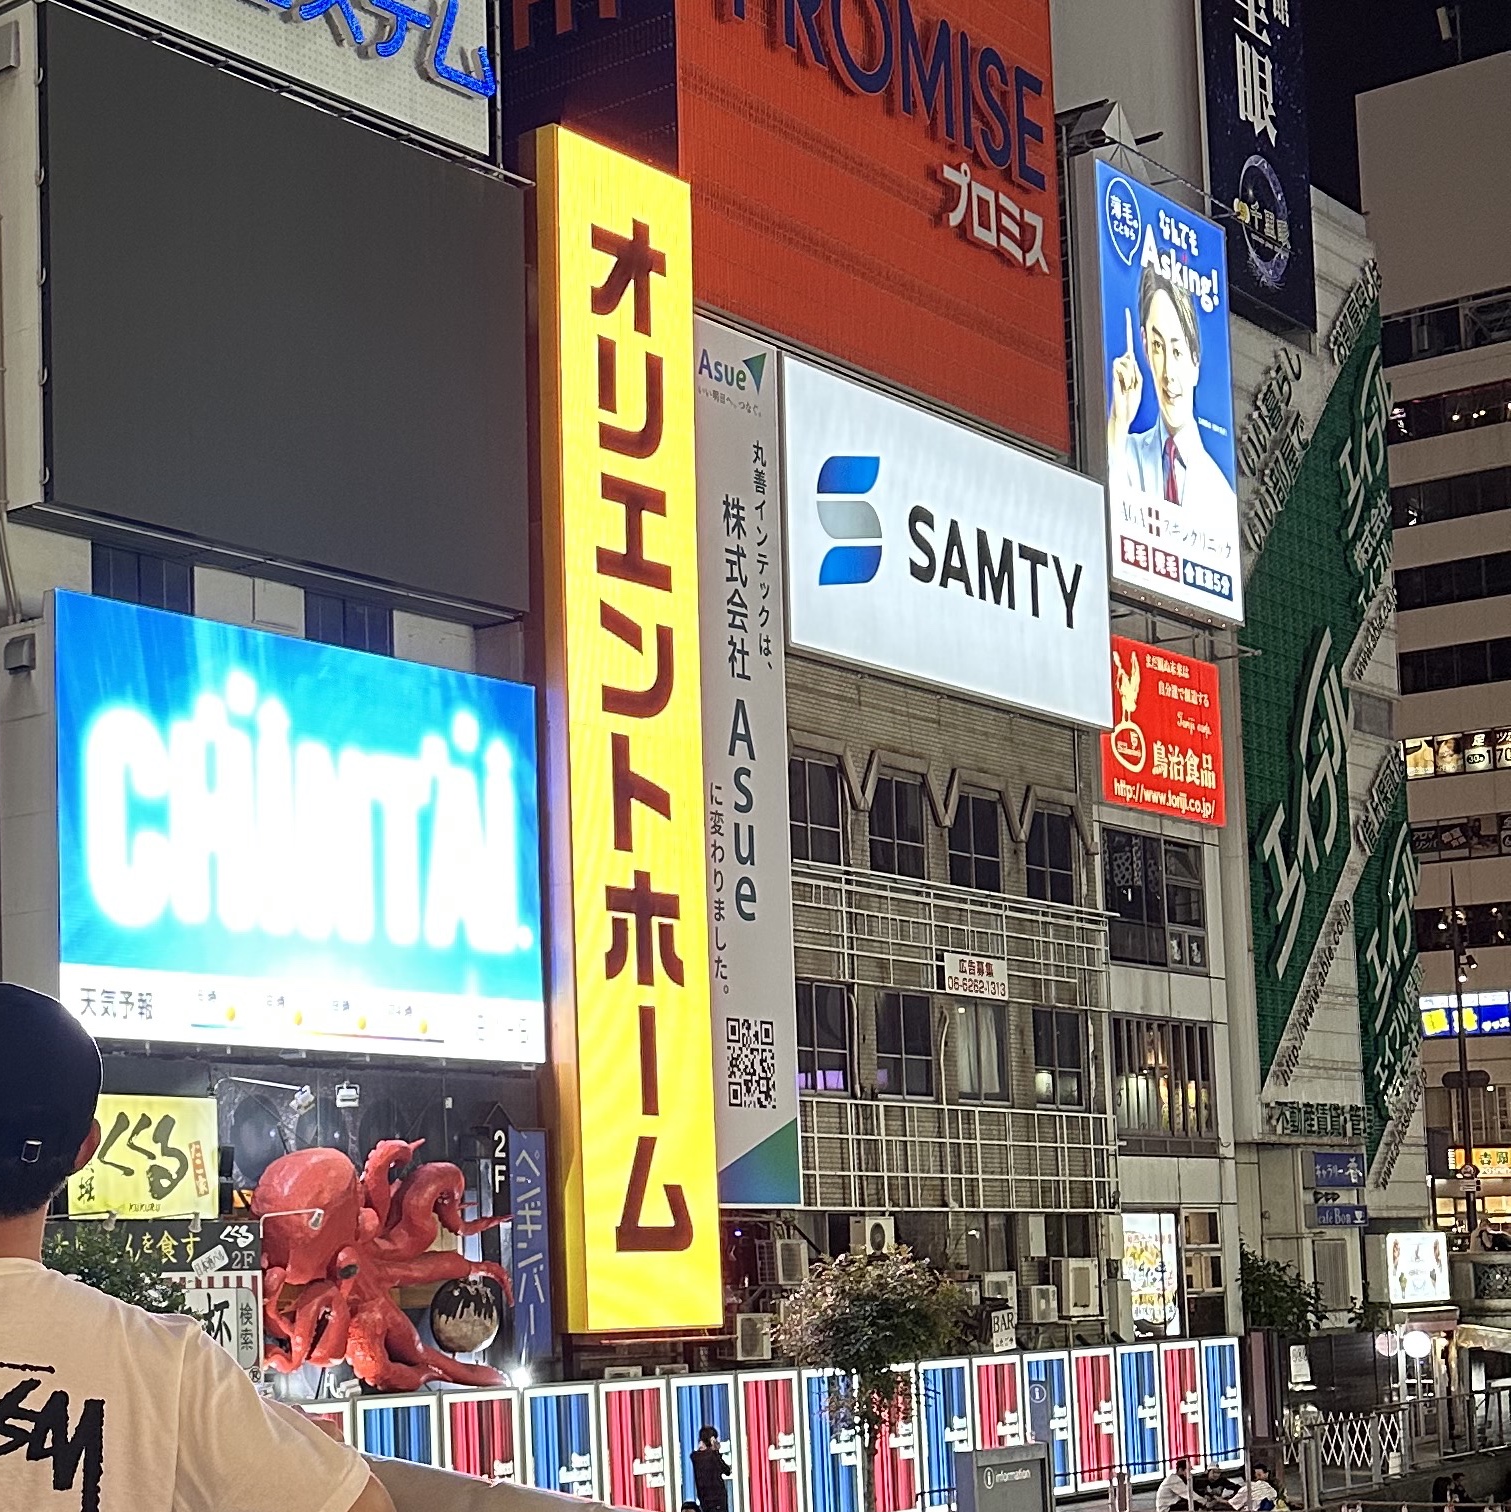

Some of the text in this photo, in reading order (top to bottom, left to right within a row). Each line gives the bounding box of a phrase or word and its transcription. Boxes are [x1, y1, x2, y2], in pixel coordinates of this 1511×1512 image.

[943, 162, 1050, 275] プロミス
[1140, 223, 1220, 311] Asking!
[698, 348, 747, 391] Asue
[723, 493, 752, 682] 株式会社
[907, 504, 1083, 630] SAMTY
[591, 218, 694, 1252] オリエントホーム
[1152, 740, 1216, 789] 鳥治食品
[709, 781, 730, 996] に変わりました。
[97, 1111, 189, 1201] くくる
[231, 1250, 256, 1269] 2F
[515, 1149, 546, 1335] ペンギンバー
[240, 1302, 254, 1350] 検索
[993, 1312, 1015, 1333] BAR
